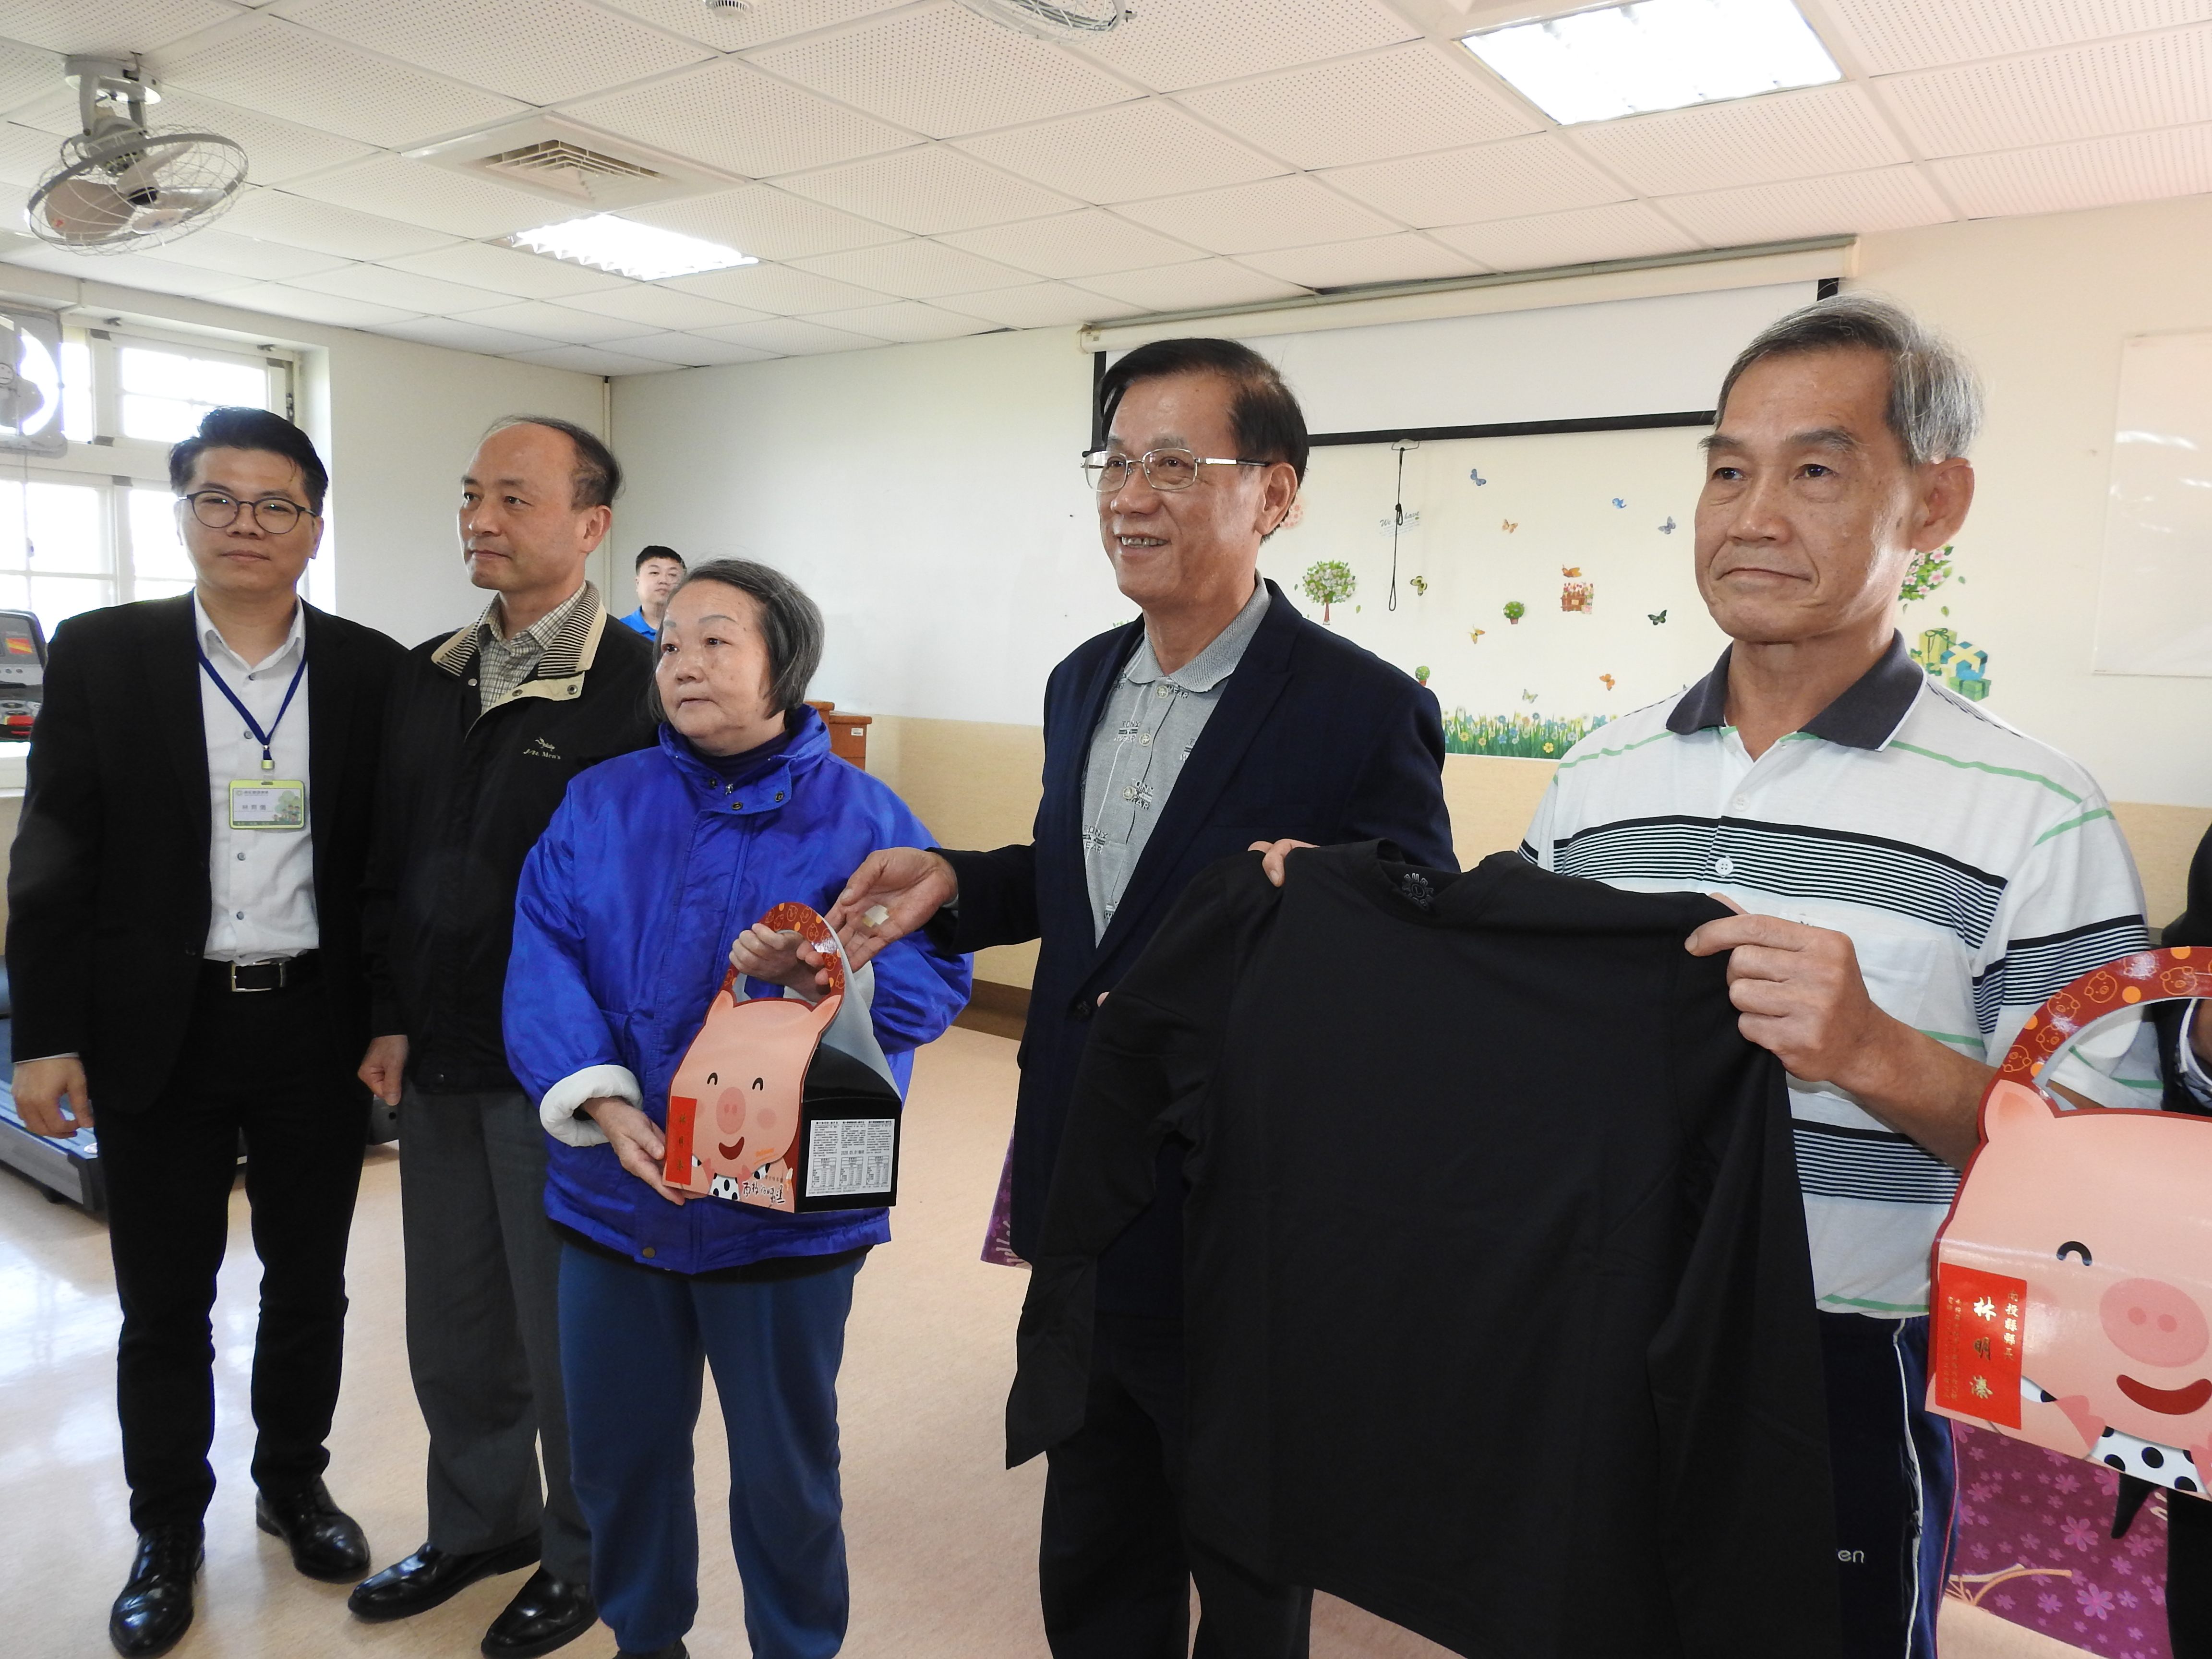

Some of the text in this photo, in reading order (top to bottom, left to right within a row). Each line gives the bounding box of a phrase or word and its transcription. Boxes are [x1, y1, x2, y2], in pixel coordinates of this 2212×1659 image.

[1131, 778, 1154, 793] TONY
[1084, 825, 1108, 839] TONY
[1836, 1549, 1864, 1563] en
